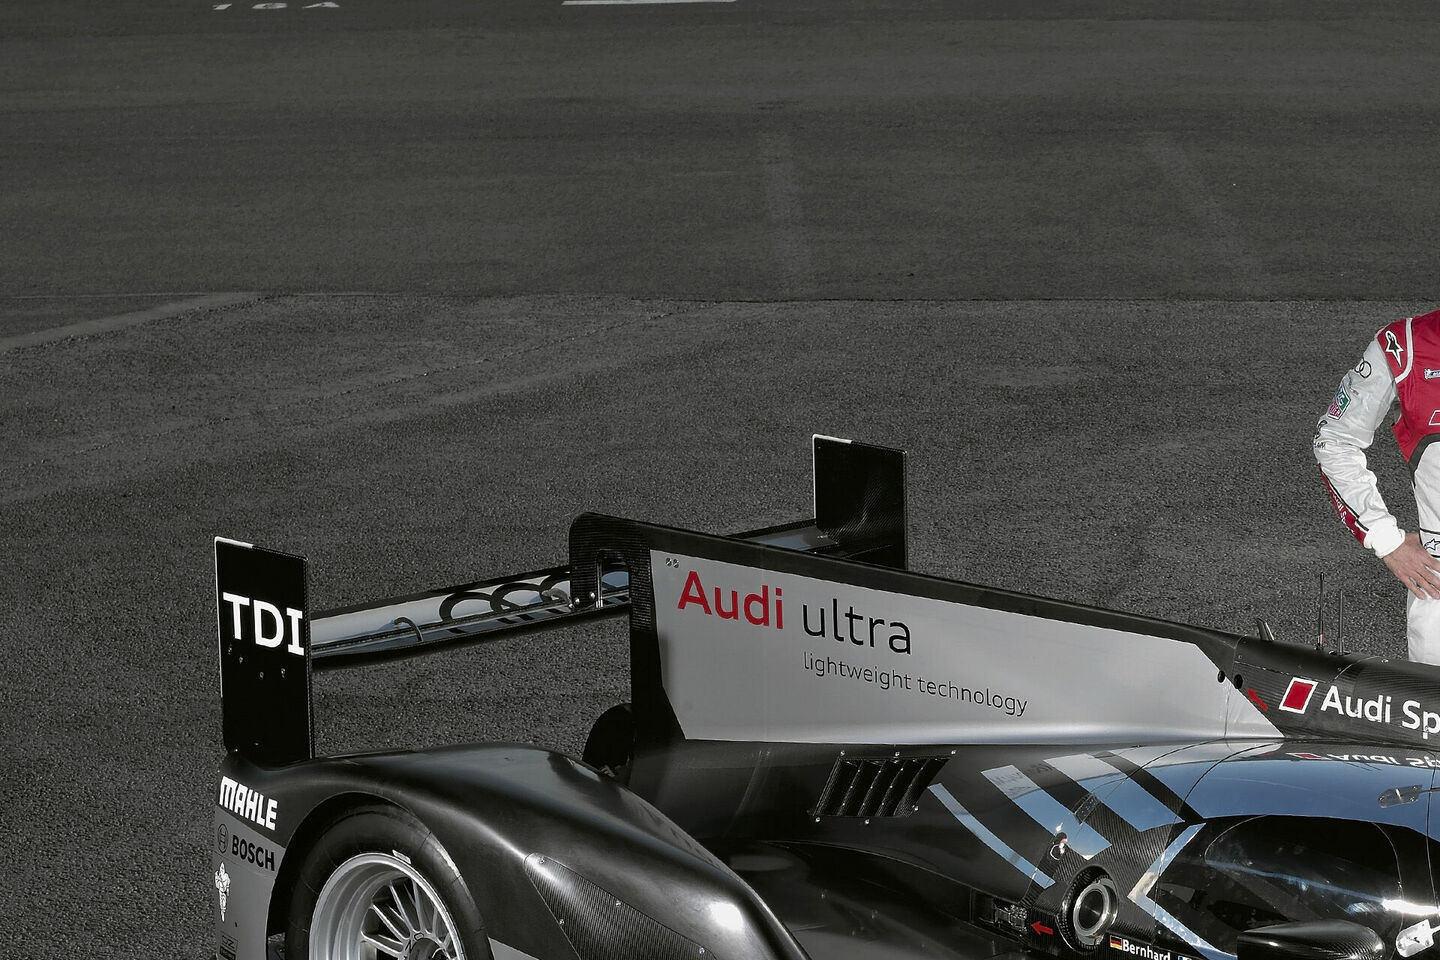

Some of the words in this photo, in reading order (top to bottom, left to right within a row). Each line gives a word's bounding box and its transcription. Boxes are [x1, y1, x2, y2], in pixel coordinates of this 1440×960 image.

[223, 593, 304, 656] TDI
[677, 571, 784, 629] Audi
[802, 598, 911, 655] ultra
[803, 651, 912, 691] lightweight
[917, 676, 1028, 716] technology
[1320, 685, 1392, 724] Audi
[219, 776, 278, 831] MAHLE
[231, 834, 276, 872] BOSCH
